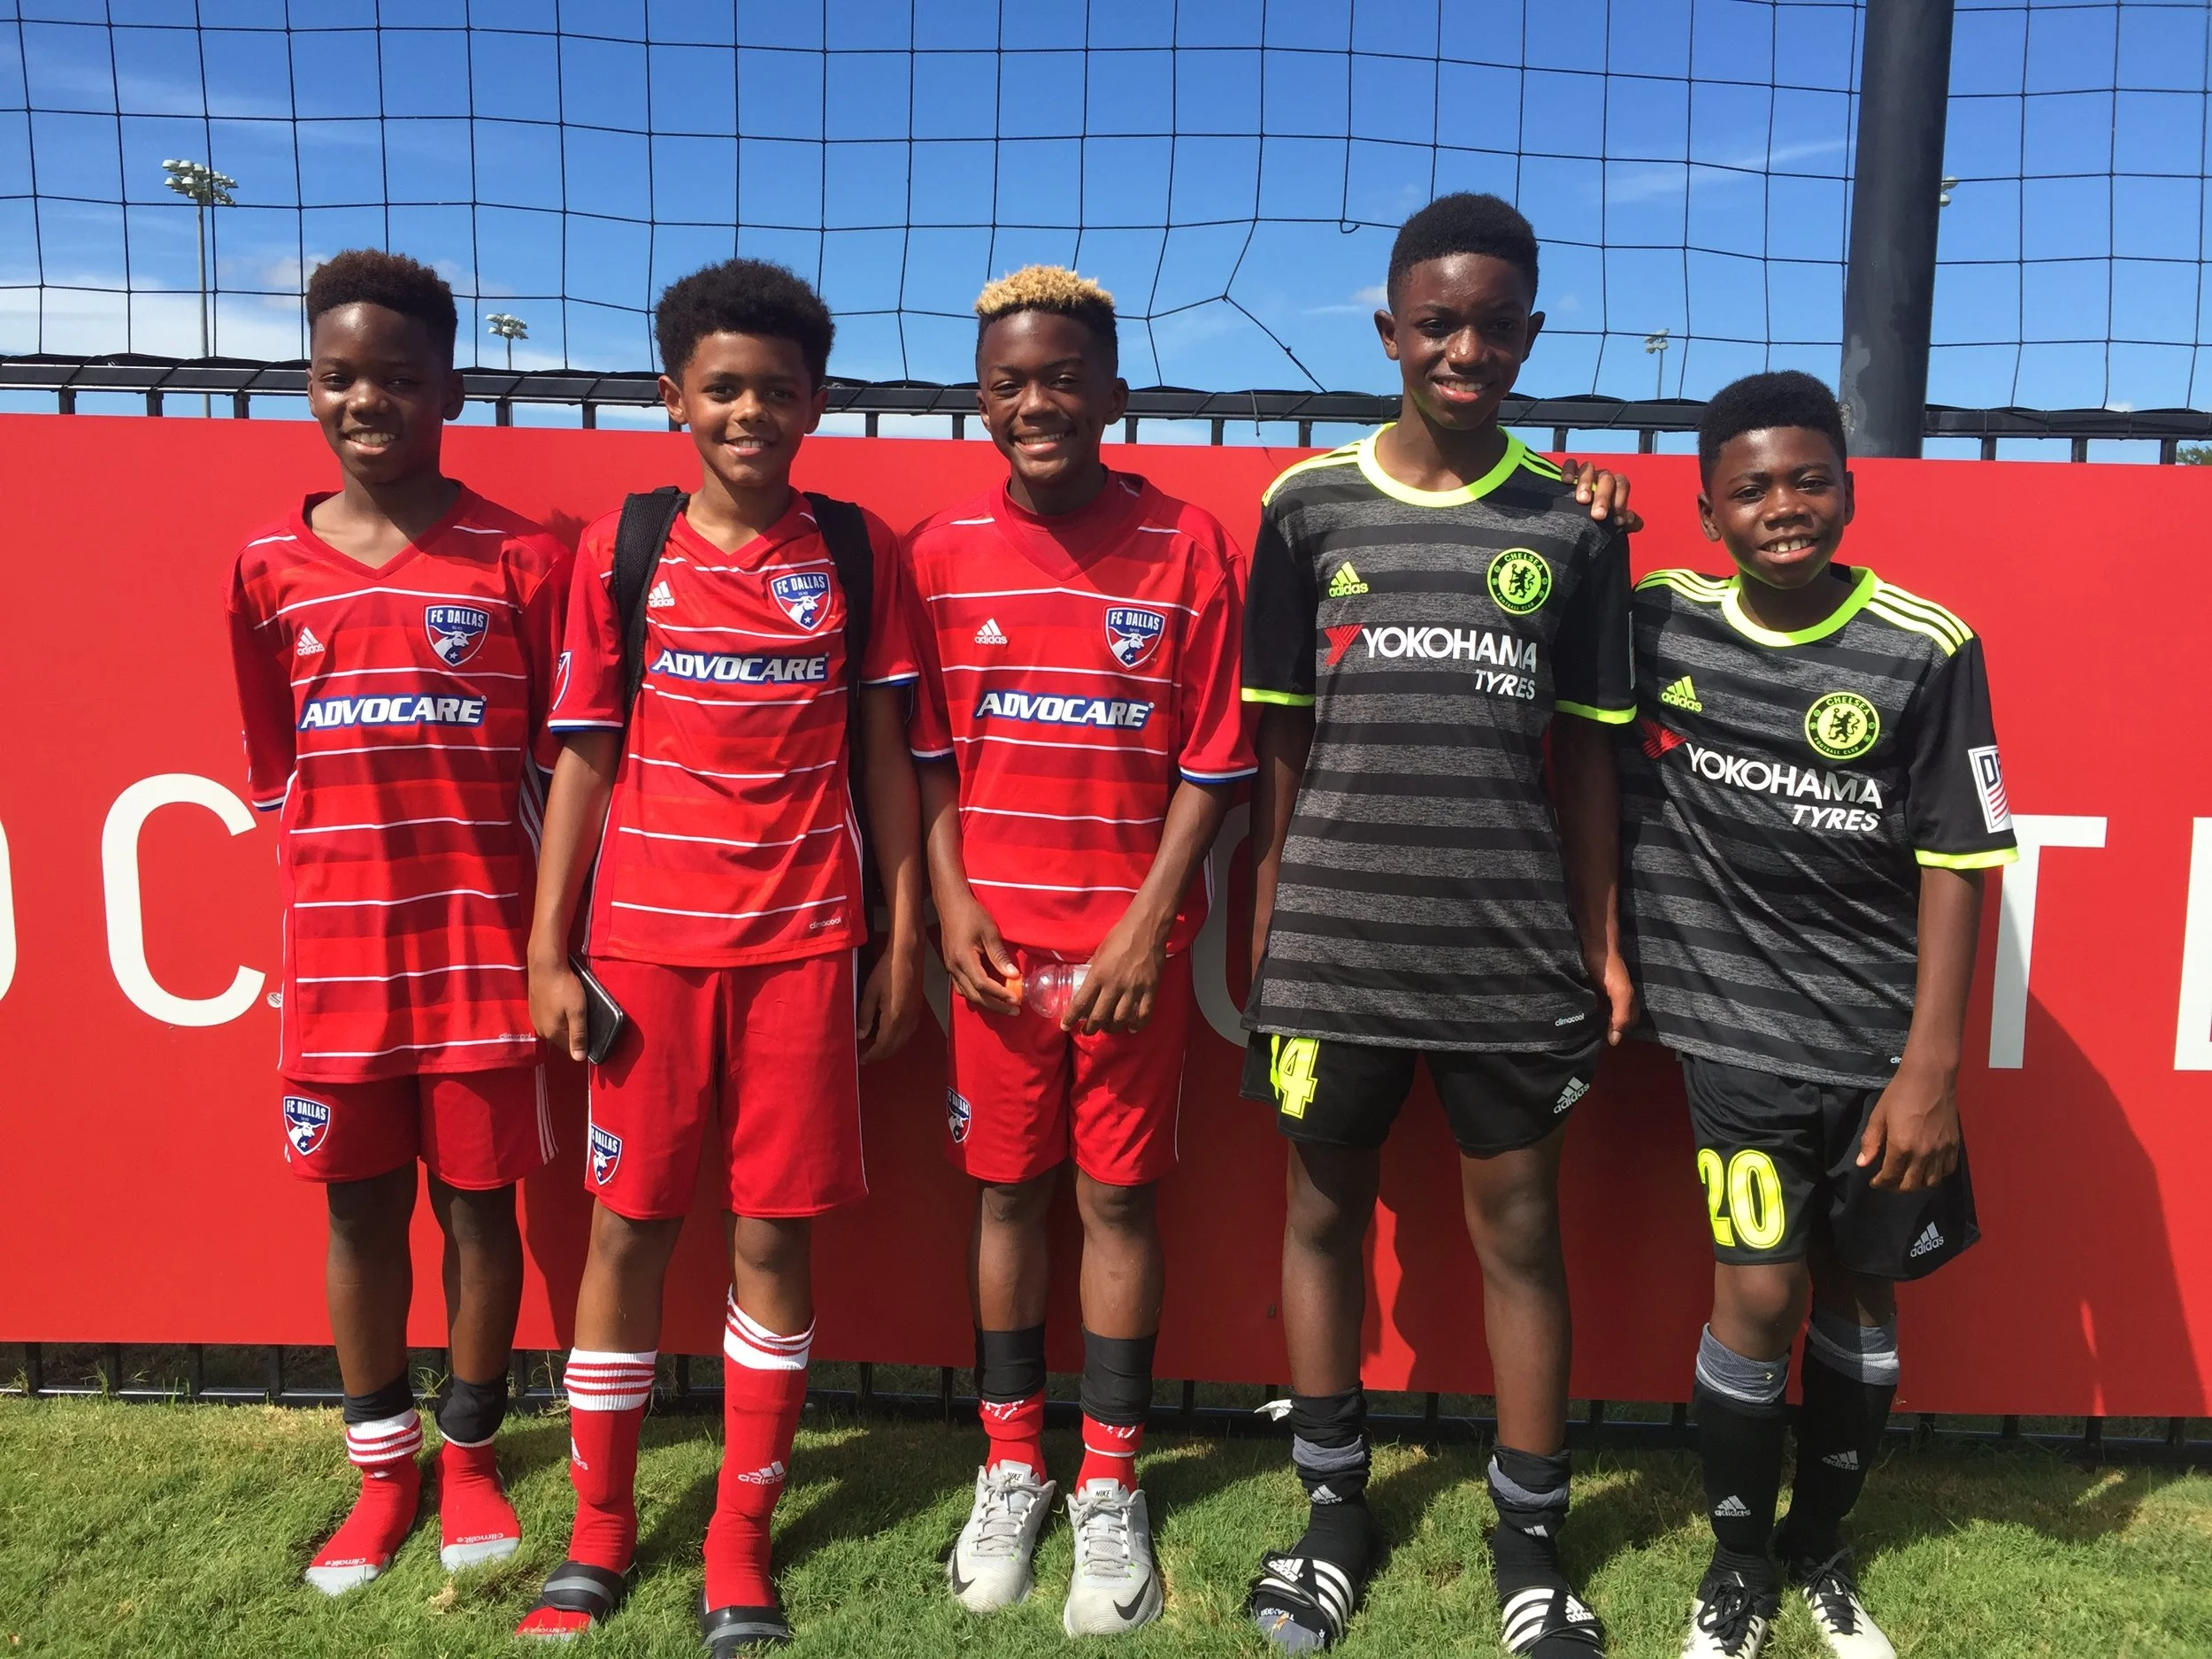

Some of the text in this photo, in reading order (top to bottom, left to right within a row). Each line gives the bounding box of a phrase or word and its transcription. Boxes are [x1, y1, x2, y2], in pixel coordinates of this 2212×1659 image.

[1504, 553, 1543, 571] CHELSEA
[777, 575, 826, 595] FC DALLAS
[1329, 581, 1369, 597] adidas
[431, 610, 484, 628] FC DALLAS
[1110, 611, 1160, 630] FC DALLAS
[297, 642, 325, 656] adidas
[974, 634, 1008, 644] adidas
[1362, 626, 1537, 673] YOKOHAMA
[652, 650, 826, 681] ADVOCARE
[1475, 669, 1536, 701] TYRES
[300, 695, 483, 729] ADVOCARE
[977, 693, 1149, 727] ADVOCARE
[1661, 691, 1702, 712] adidas
[1825, 696, 1870, 716] CHELSEA
[1686, 742, 1883, 809] YOKOHAMA
[1793, 804, 1881, 832] TYRES
[1555, 1013, 1585, 1026] climacool
[1553, 1083, 1590, 1114] adidas
[286, 1100, 326, 1120] FC DALLAS
[1697, 1148, 1786, 1248] 20
[1910, 1236, 1944, 1257] adidas
